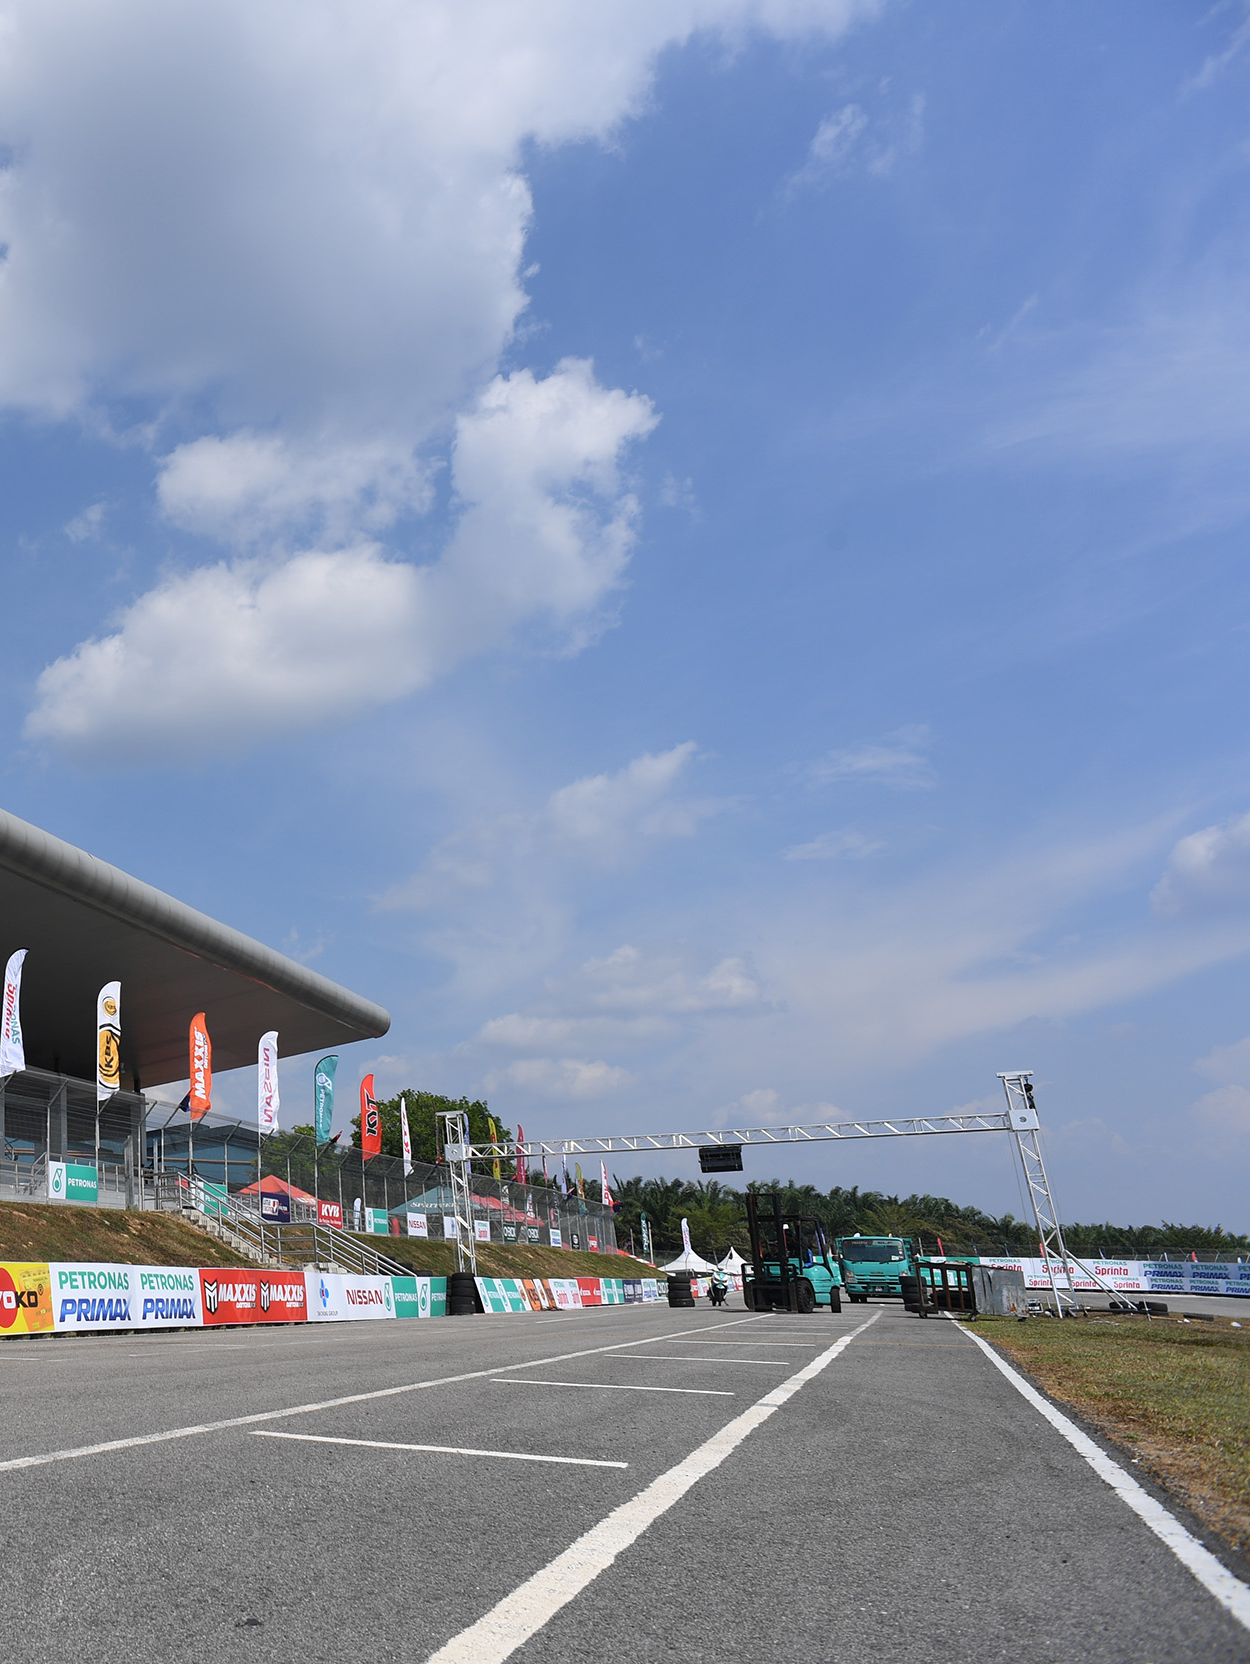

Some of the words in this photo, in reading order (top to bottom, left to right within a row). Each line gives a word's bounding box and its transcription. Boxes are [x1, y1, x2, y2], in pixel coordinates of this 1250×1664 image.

[194, 1030, 207, 1100] MAXXIS
[363, 1089, 379, 1136] KYT
[67, 1177, 97, 1190] PETRONAS
[321, 1204, 340, 1218] KYB
[1094, 1265, 1129, 1276] Sprinta
[1143, 1270, 1185, 1278] PRIMAX
[1192, 1271, 1230, 1280] PRIMAX
[58, 1271, 130, 1291] PETRONAS
[140, 1273, 194, 1291] PETRONAS
[1113, 1281, 1141, 1289] Sprinta
[1151, 1283, 1185, 1291] PRIMAX
[218, 1283, 256, 1302] MAXXIS
[270, 1284, 304, 1302] MAXXIS
[346, 1289, 384, 1305] NISSAN
[395, 1292, 418, 1302] PETRONAS
[59, 1298, 132, 1322] PRIMAX
[142, 1298, 196, 1320] PRIMAX
